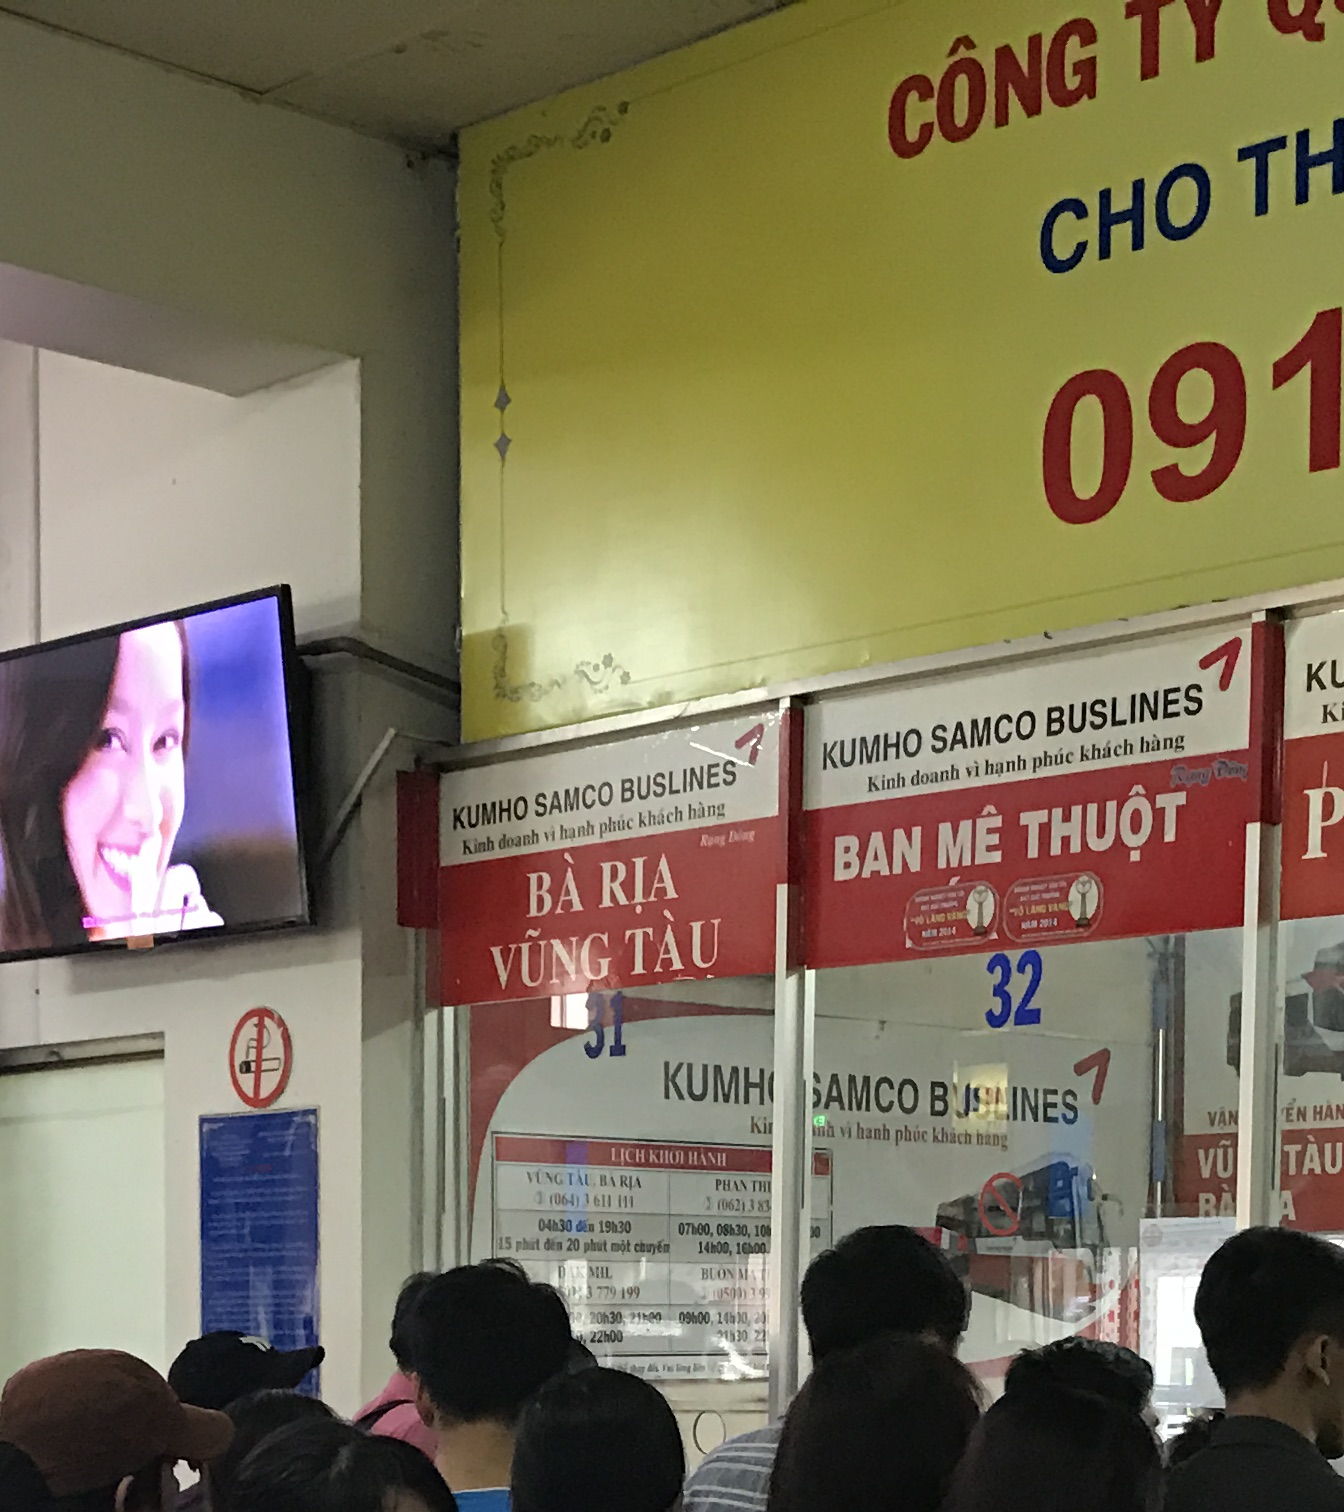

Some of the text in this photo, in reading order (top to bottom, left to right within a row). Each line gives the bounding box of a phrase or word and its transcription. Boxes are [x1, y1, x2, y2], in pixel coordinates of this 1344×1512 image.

[887, 36, 1099, 160] CÔNG
[1137, 0, 1224, 82] TY
[1039, 162, 1213, 274] CHO
[822, 684, 1203, 771] KUMHO SAMCO BUSLINES
[453, 760, 737, 830] KUMHO SAMCO BUSLINES
[867, 733, 1185, 793] Kinh doanh vì hạnh phúc khách hàng
[462, 838, 494, 856] Kinh
[499, 831, 539, 851] doanh
[559, 821, 595, 842] hạnh
[599, 814, 634, 837] phúc
[638, 807, 683, 827] khách
[687, 801, 725, 820] hàng
[833, 784, 1186, 882] BAN MÊ THUỘT
[526, 852, 678, 918] BÀ RỊA
[490, 909, 721, 990] VŨNG TÀU
[984, 949, 1043, 1029] 32
[584, 990, 626, 1059] 31
[611, 1147, 645, 1165] LỊCH
[1283, 1140, 1343, 1176] TÀU
[567, 1238, 580, 1252] 20
[598, 1221, 631, 1234] 19h30
